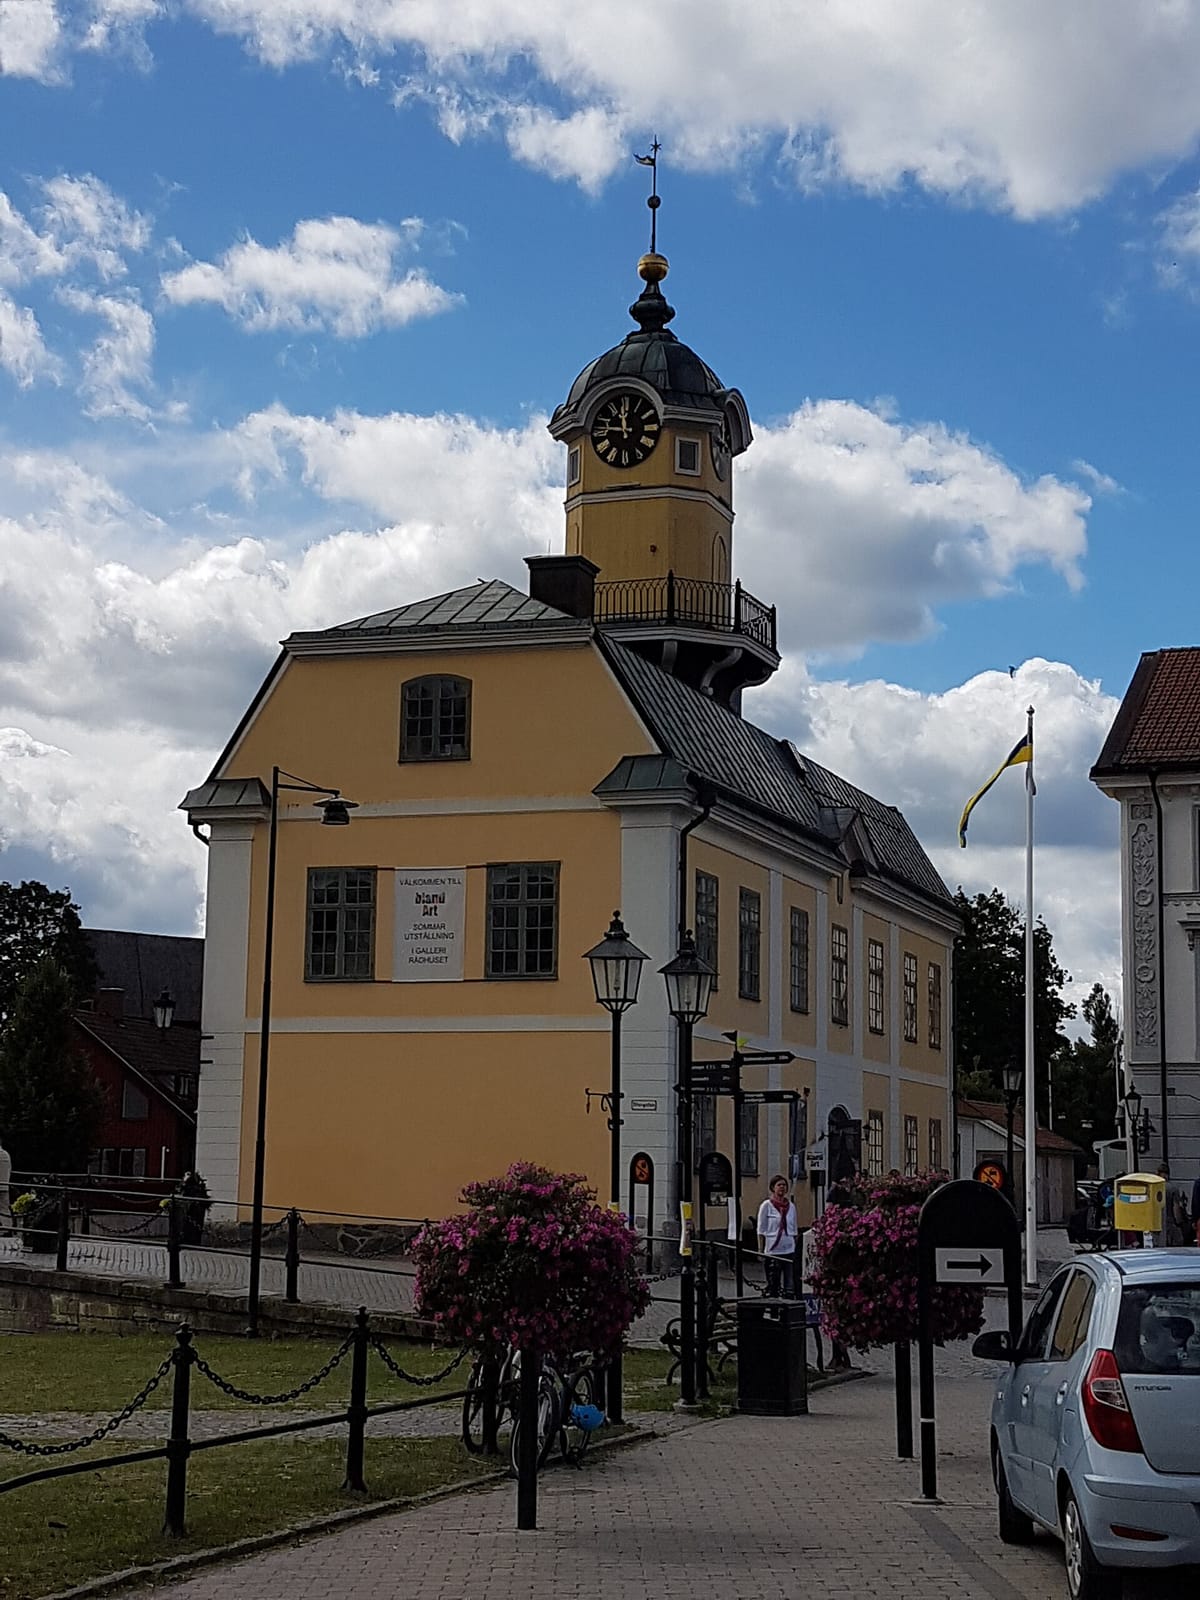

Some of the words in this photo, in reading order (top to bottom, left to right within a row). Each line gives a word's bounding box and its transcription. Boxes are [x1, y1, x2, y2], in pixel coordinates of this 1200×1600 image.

[448, 877, 462, 886] TILL
[415, 892, 446, 904] bland
[422, 905, 438, 917] Art
[412, 923, 446, 931] SOMMAR
